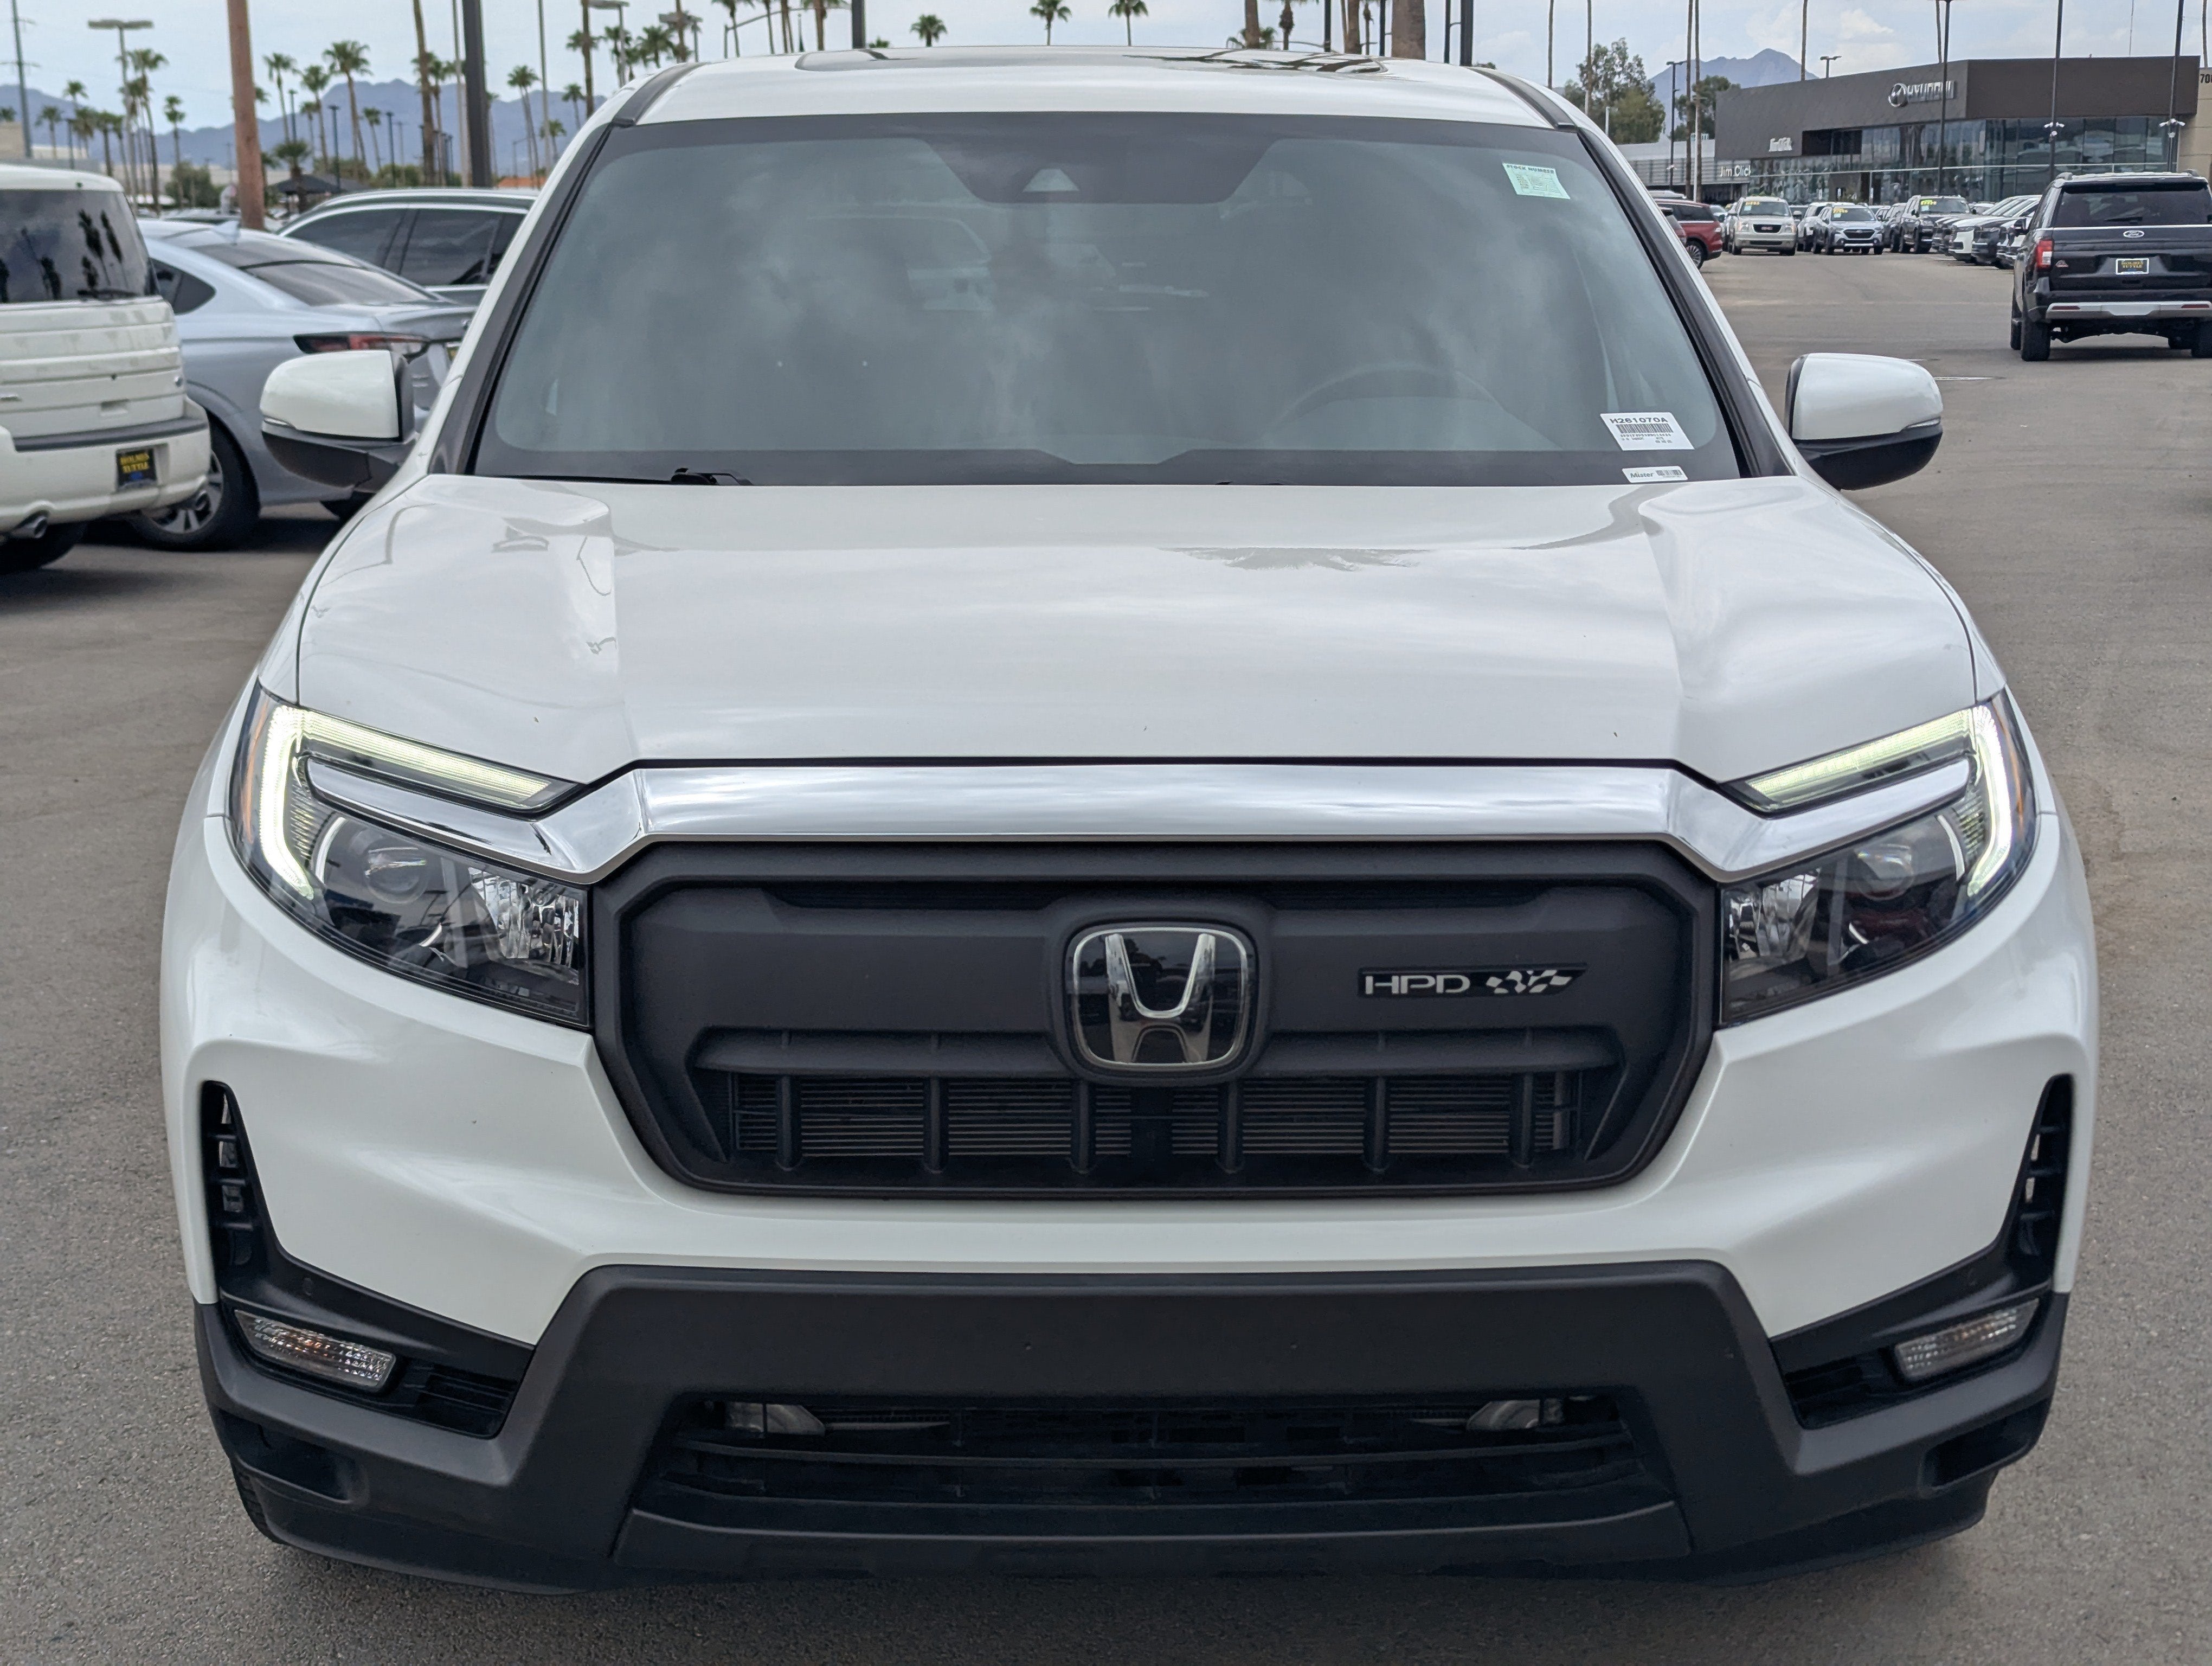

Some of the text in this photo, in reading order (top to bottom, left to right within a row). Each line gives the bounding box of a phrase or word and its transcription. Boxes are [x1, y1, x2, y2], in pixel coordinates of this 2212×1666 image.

[2200, 74, 2212, 84] 70
[1720, 167, 1732, 177] Jim
[1365, 974, 1471, 995] HPD
